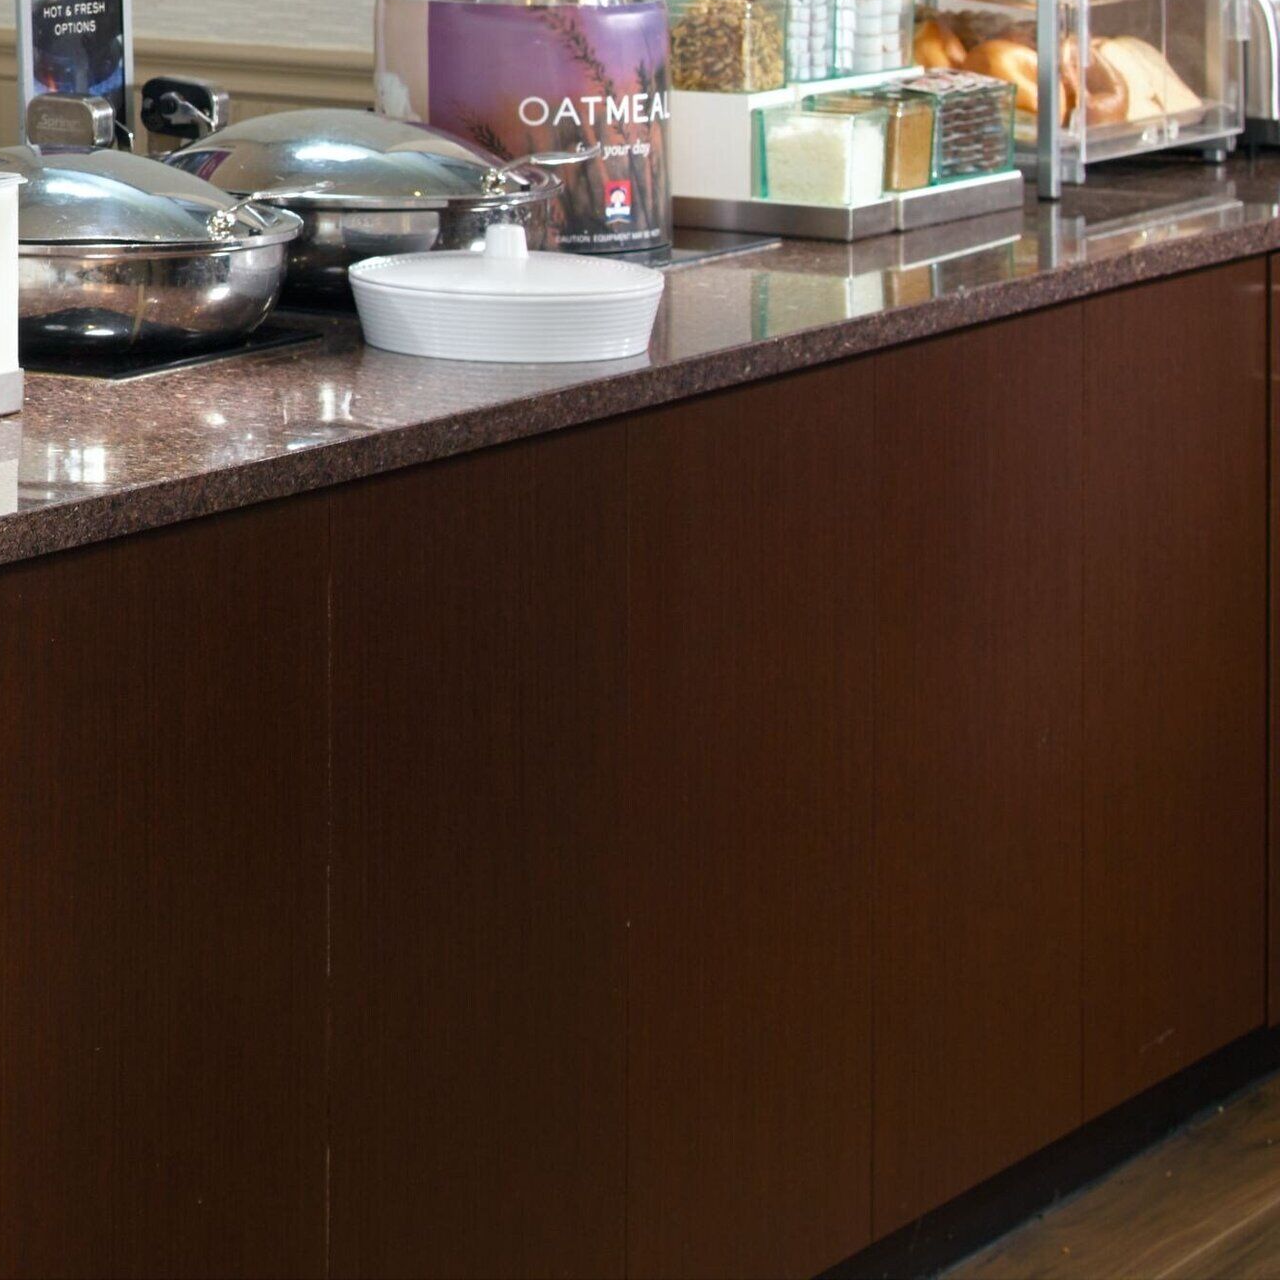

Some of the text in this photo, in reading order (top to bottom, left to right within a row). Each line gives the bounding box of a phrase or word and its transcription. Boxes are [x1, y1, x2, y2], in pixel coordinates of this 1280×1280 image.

[43, 1, 107, 19] HOT & FRESH
[53, 20, 97, 36] OPTIONS
[518, 91, 671, 126] OATMEAL
[602, 145, 631, 161] your
[632, 138, 651, 158] day
[555, 233, 591, 243] CAUTION
